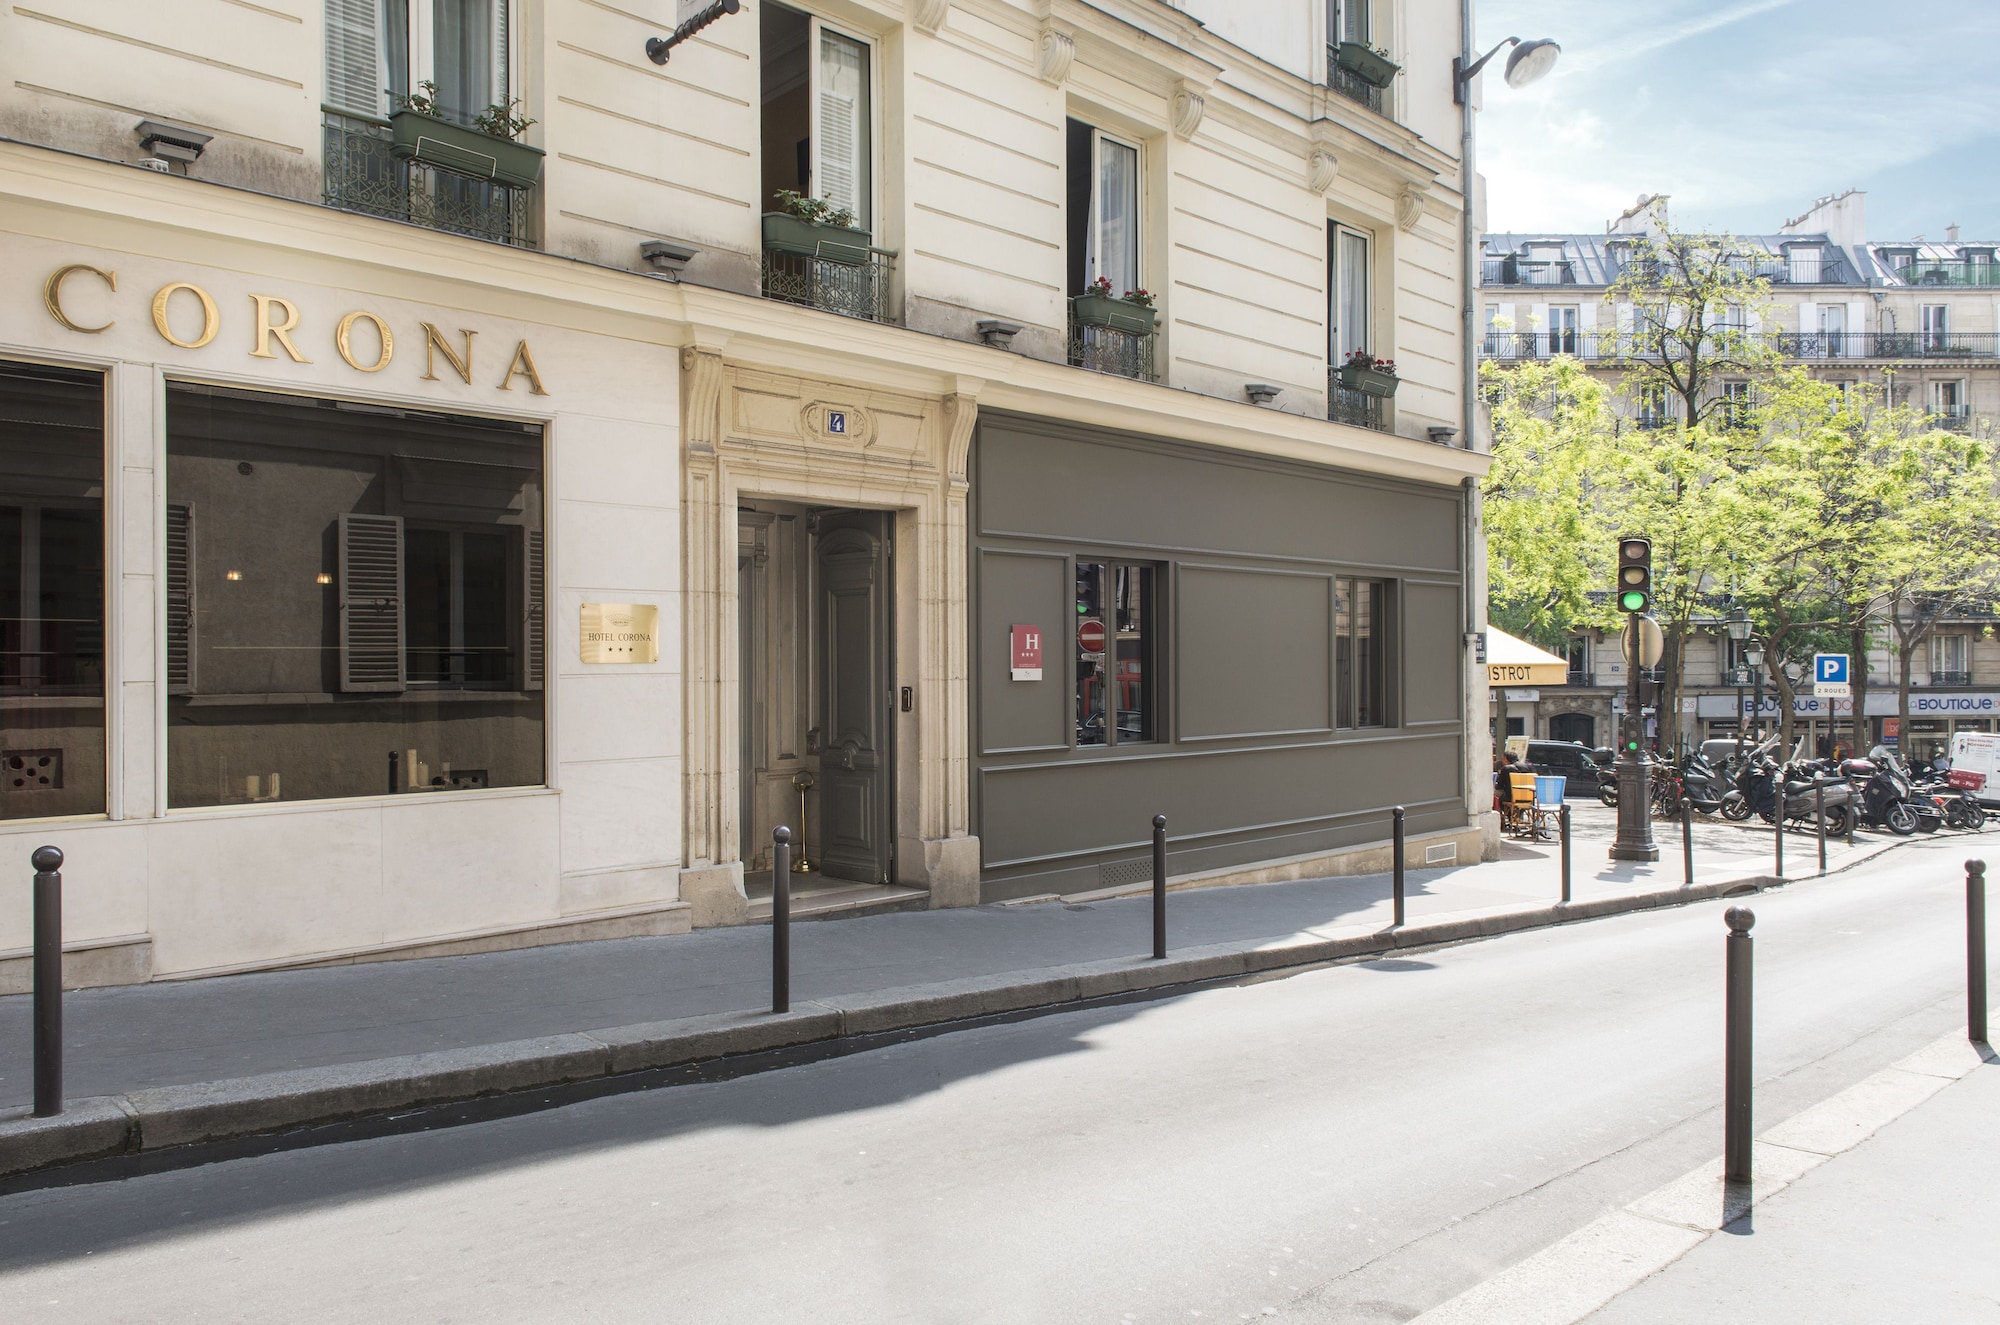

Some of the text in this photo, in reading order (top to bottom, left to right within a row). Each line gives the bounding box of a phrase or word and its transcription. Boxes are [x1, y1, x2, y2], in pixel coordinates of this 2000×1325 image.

[44, 263, 550, 397] CORONA
[832, 415, 843, 431] 4
[588, 632, 651, 642] HOTEL CORONA
[1025, 633, 1040, 650] H
[1487, 666, 1531, 681] ISTROT
[1823, 659, 1840, 679] P
[1683, 701, 1695, 709] OS
